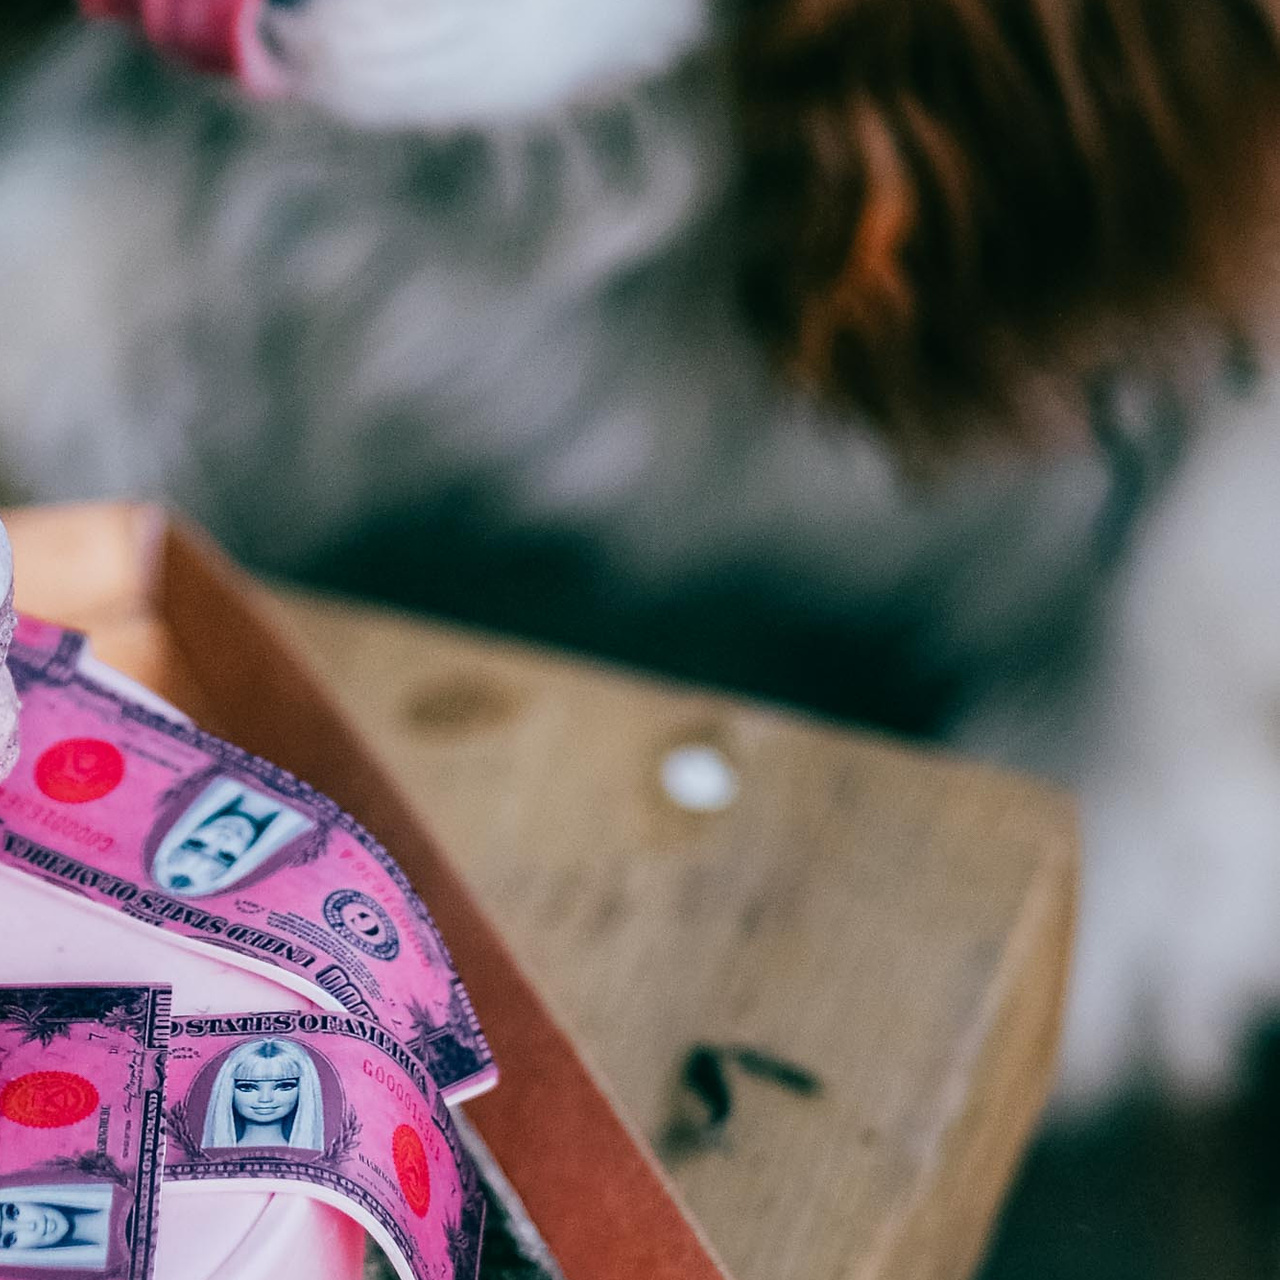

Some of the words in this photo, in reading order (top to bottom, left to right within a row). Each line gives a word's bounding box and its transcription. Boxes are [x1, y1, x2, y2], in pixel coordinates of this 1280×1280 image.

[3, 830, 107, 894] AMERICA
[139, 891, 228, 935] STATES
[226, 923, 317, 970] UNITED
[185, 1014, 297, 1038] STATES
[298, 1013, 342, 1035] OF
[340, 1018, 431, 1102] AMERICA
